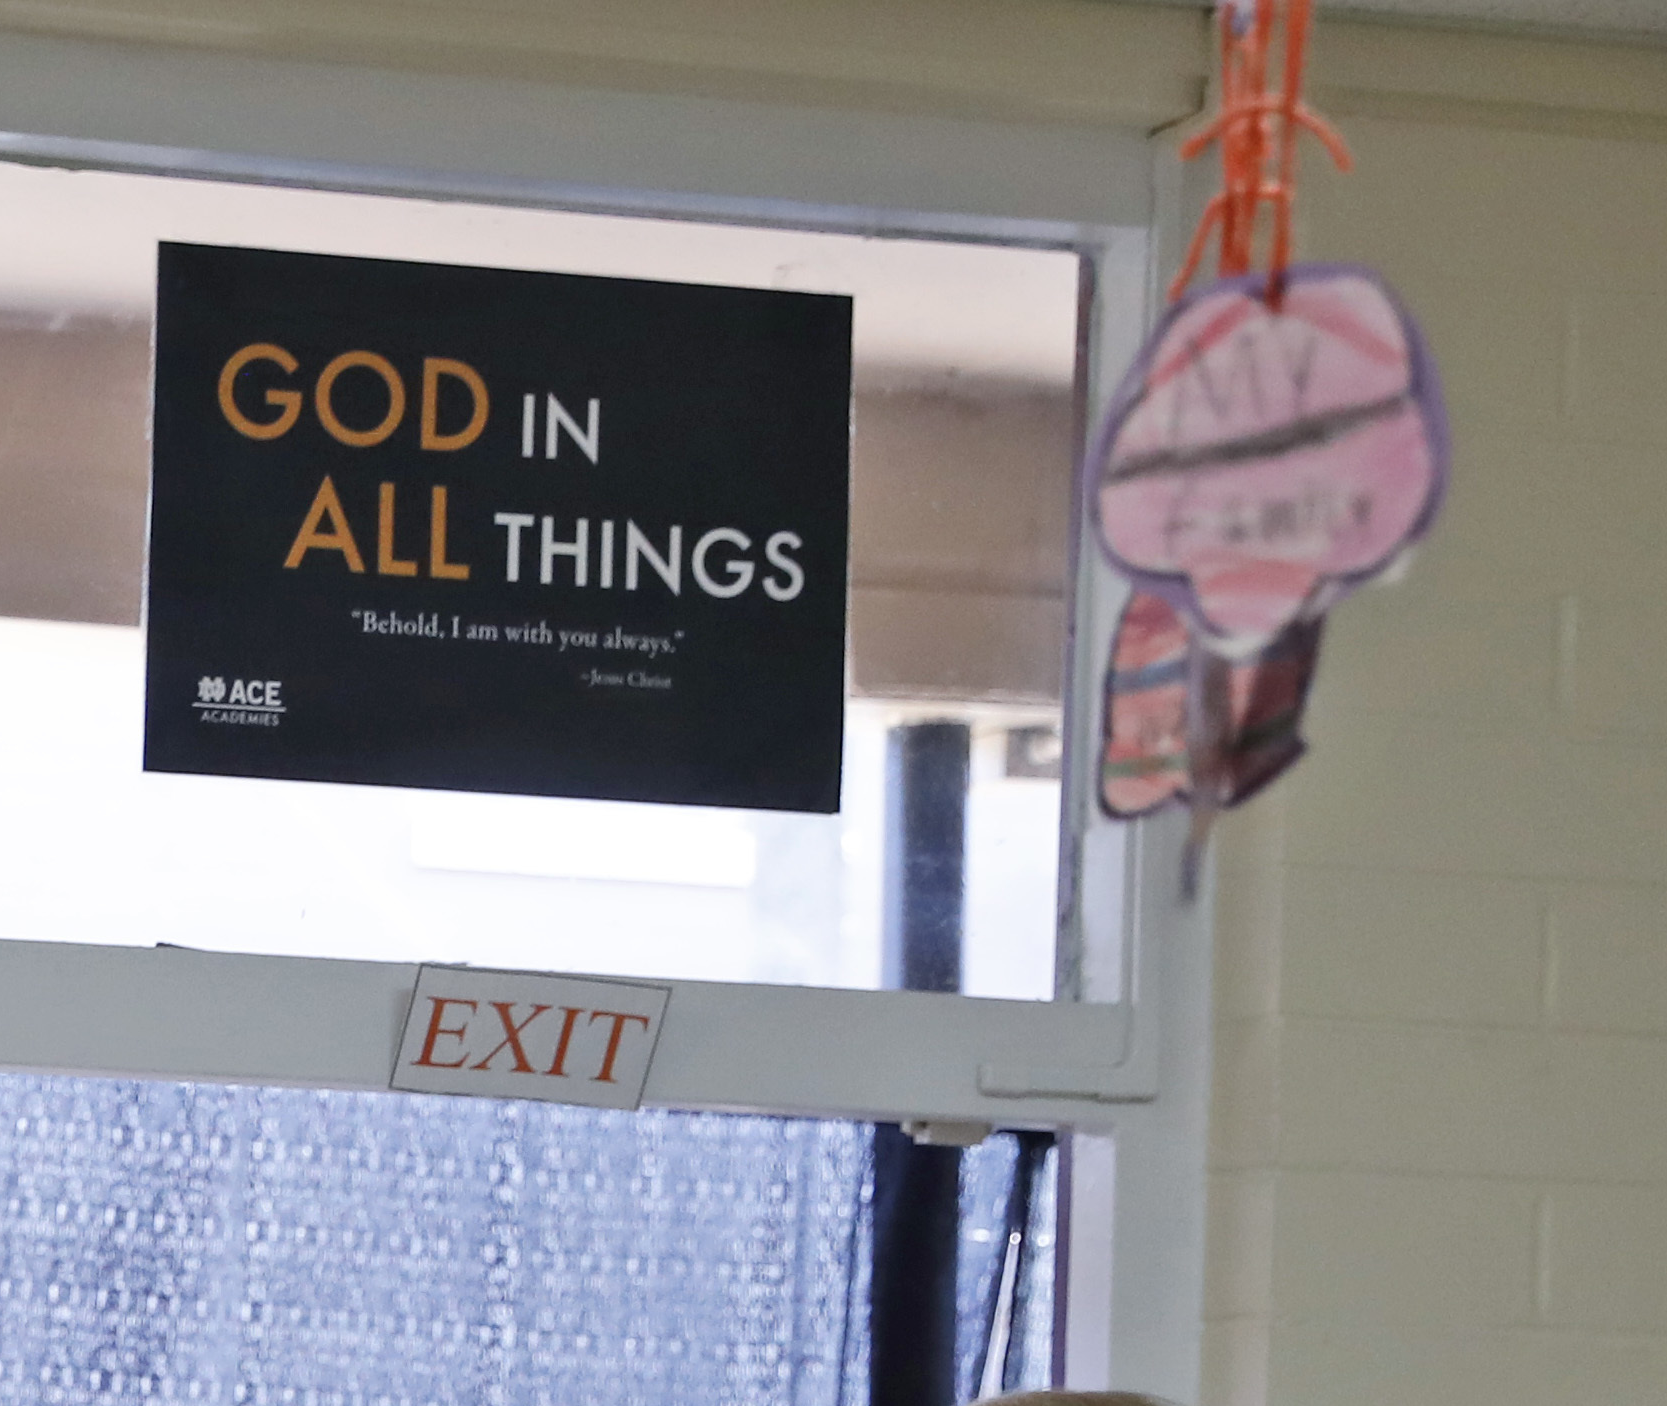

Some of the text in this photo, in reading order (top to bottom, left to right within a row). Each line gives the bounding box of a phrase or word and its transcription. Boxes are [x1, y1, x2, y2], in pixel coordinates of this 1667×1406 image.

[217, 342, 601, 465] GOD IN
[283, 475, 805, 603] ALL THINGS
[451, 615, 460, 639] I
[466, 622, 498, 641] am
[505, 620, 553, 645] with
[559, 630, 597, 652] you
[200, 710, 280, 727] ACADEMIES
[229, 679, 282, 706] ACE
[410, 995, 651, 1084] EXIT
